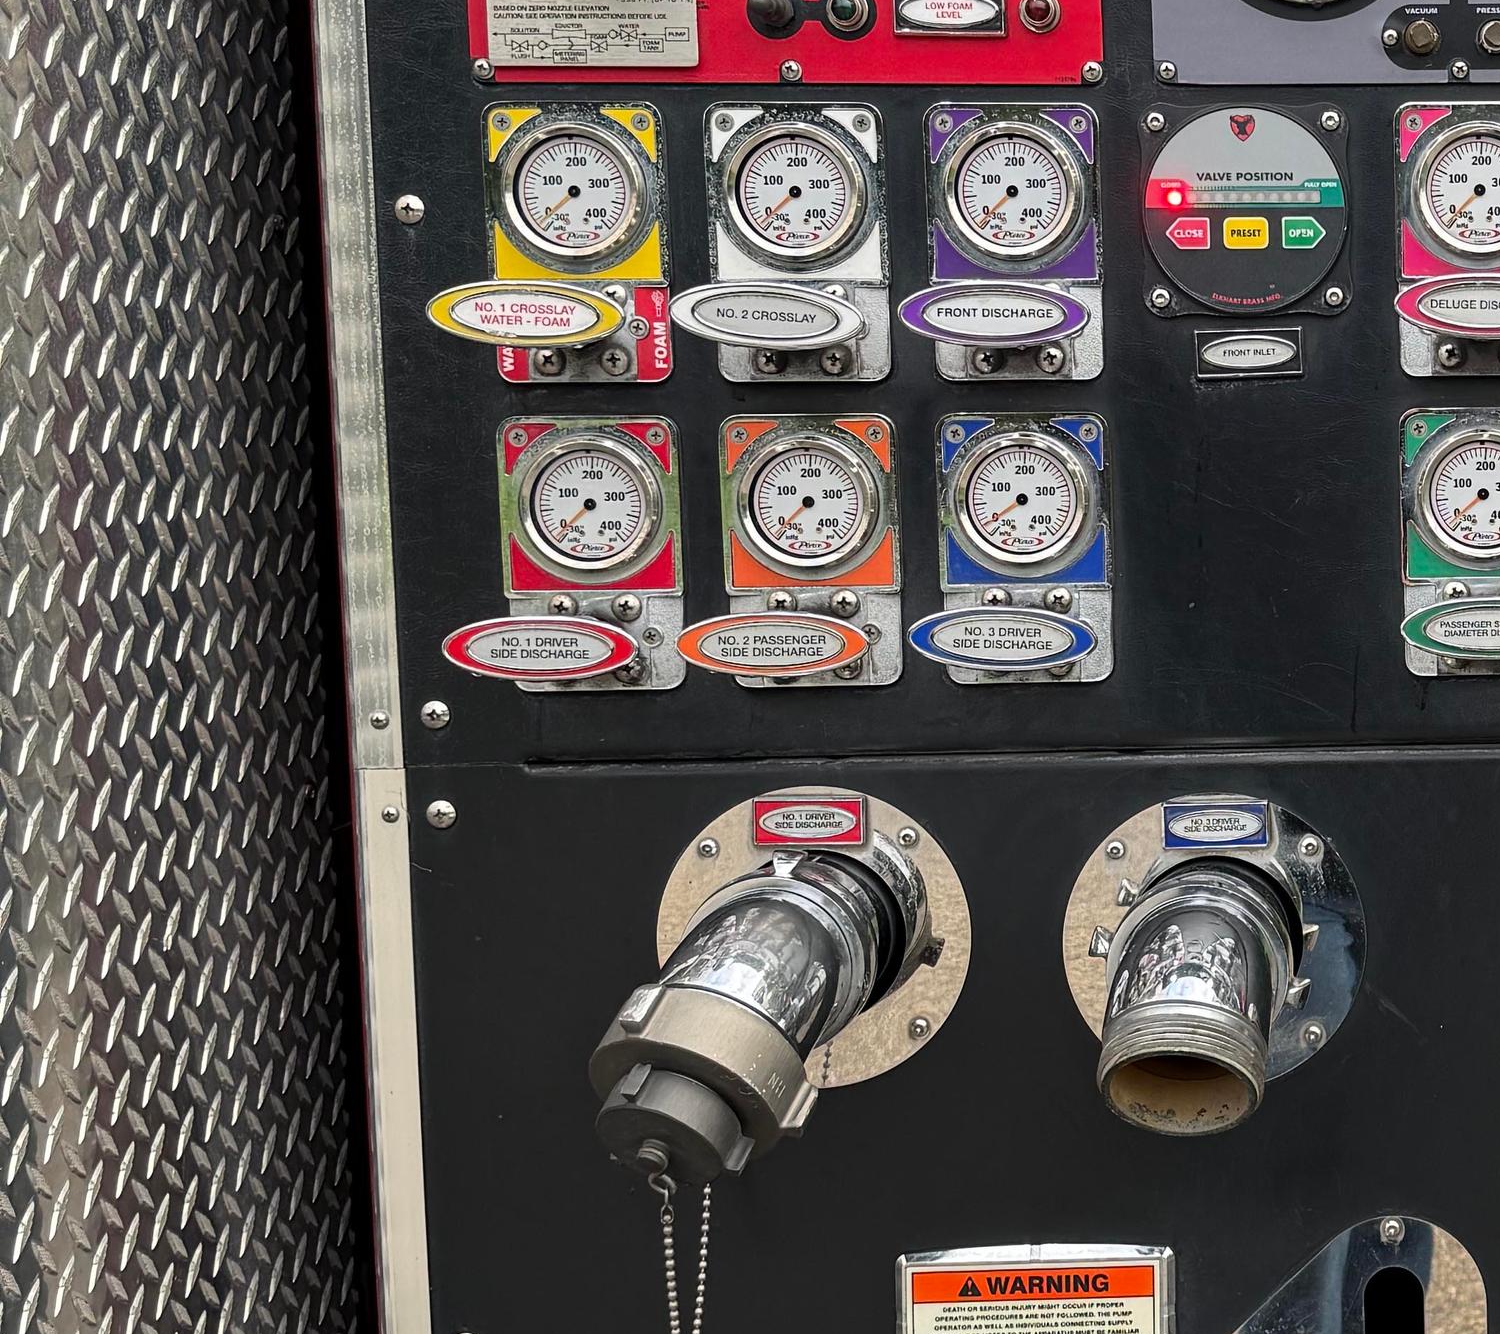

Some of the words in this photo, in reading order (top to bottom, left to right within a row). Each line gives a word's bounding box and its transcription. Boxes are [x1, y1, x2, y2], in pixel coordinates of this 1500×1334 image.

[925, 1, 945, 11] LOW
[946, 1, 974, 11] FOAM
[935, 10, 963, 19] LEVEL
[1196, 171, 1232, 182] VALVE
[1236, 171, 1294, 182] POSITION
[1174, 229, 1204, 238] CLOSE
[1230, 229, 1262, 238] PRESET
[1288, 228, 1314, 238] OPEN
[474, 301, 498, 313] NO.
[499, 303, 506, 313] 1
[510, 303, 576, 316] CROSSLAY
[1430, 298, 1477, 310] DELUGE
[716, 308, 738, 320] NO.
[741, 309, 749, 320] 2
[751, 310, 817, 324] CROSSLAY
[937, 307, 979, 318] FRONT
[981, 307, 1054, 319] DISCHARGE
[480, 315, 523, 326] WATER
[534, 316, 571, 327] FOAM
[654, 321, 668, 369] FOAM
[1223, 348, 1251, 357] FRONT
[1253, 348, 1276, 356] INLET
[964, 626, 985, 637] NO.
[988, 627, 996, 637] 3
[998, 627, 1042, 638] DRIVER
[501, 637, 523, 648] NO.
[526, 637, 531, 648] 1
[535, 637, 579, 648] DRIVER
[717, 635, 740, 646] NO.
[742, 635, 750, 646] 2
[753, 635, 827, 646] PASSENGER
[952, 638, 980, 650] SIDE
[983, 639, 1053, 651] DISCHARGE
[490, 648, 518, 659] SIDE
[520, 648, 591, 660] DISCHARGE
[721, 647, 749, 658] SIDE
[752, 646, 825, 658] DISCHARGE
[782, 813, 797, 821] NO.
[805, 812, 835, 820] DRIVER
[774, 821, 793, 829] SIDE
[795, 820, 843, 829] DISCHARGE
[986, 1273, 1110, 1295] WARNING
